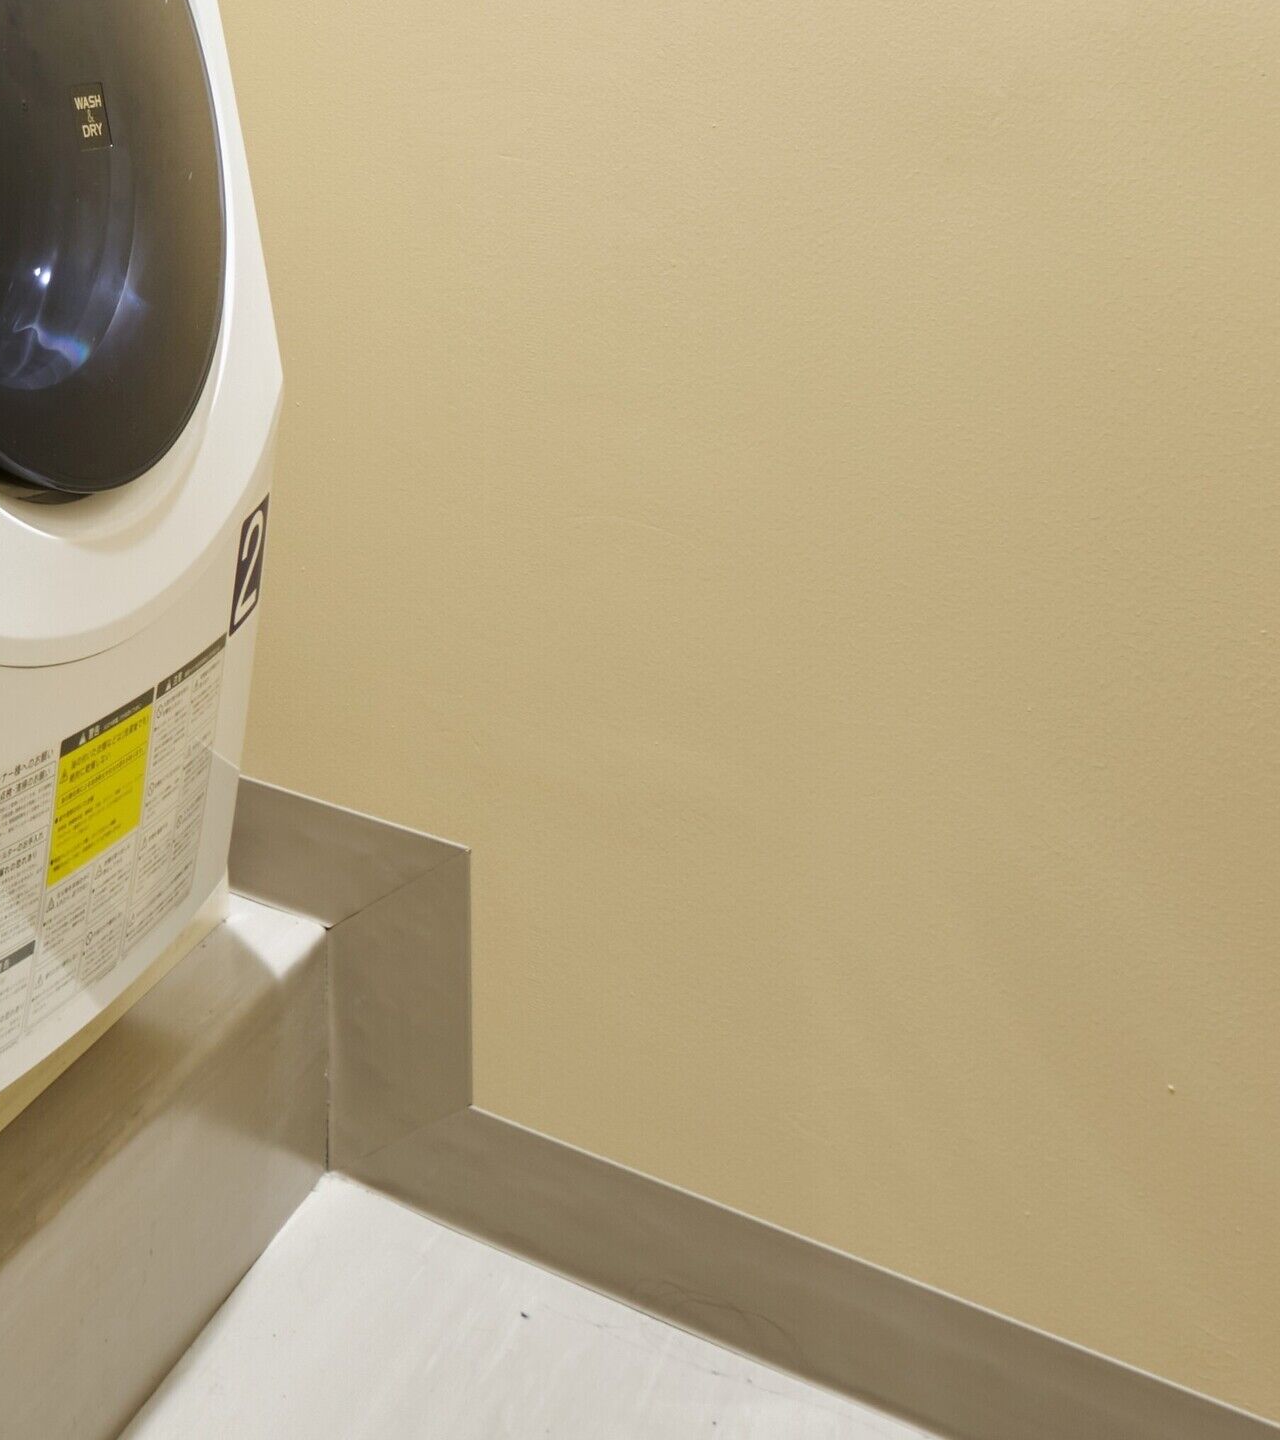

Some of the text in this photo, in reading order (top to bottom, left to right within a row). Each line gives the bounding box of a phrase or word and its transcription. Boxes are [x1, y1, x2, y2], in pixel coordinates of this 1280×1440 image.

[74, 94, 101, 110] WASH
[82, 122, 102, 138] DRY
[234, 510, 264, 625] 2
